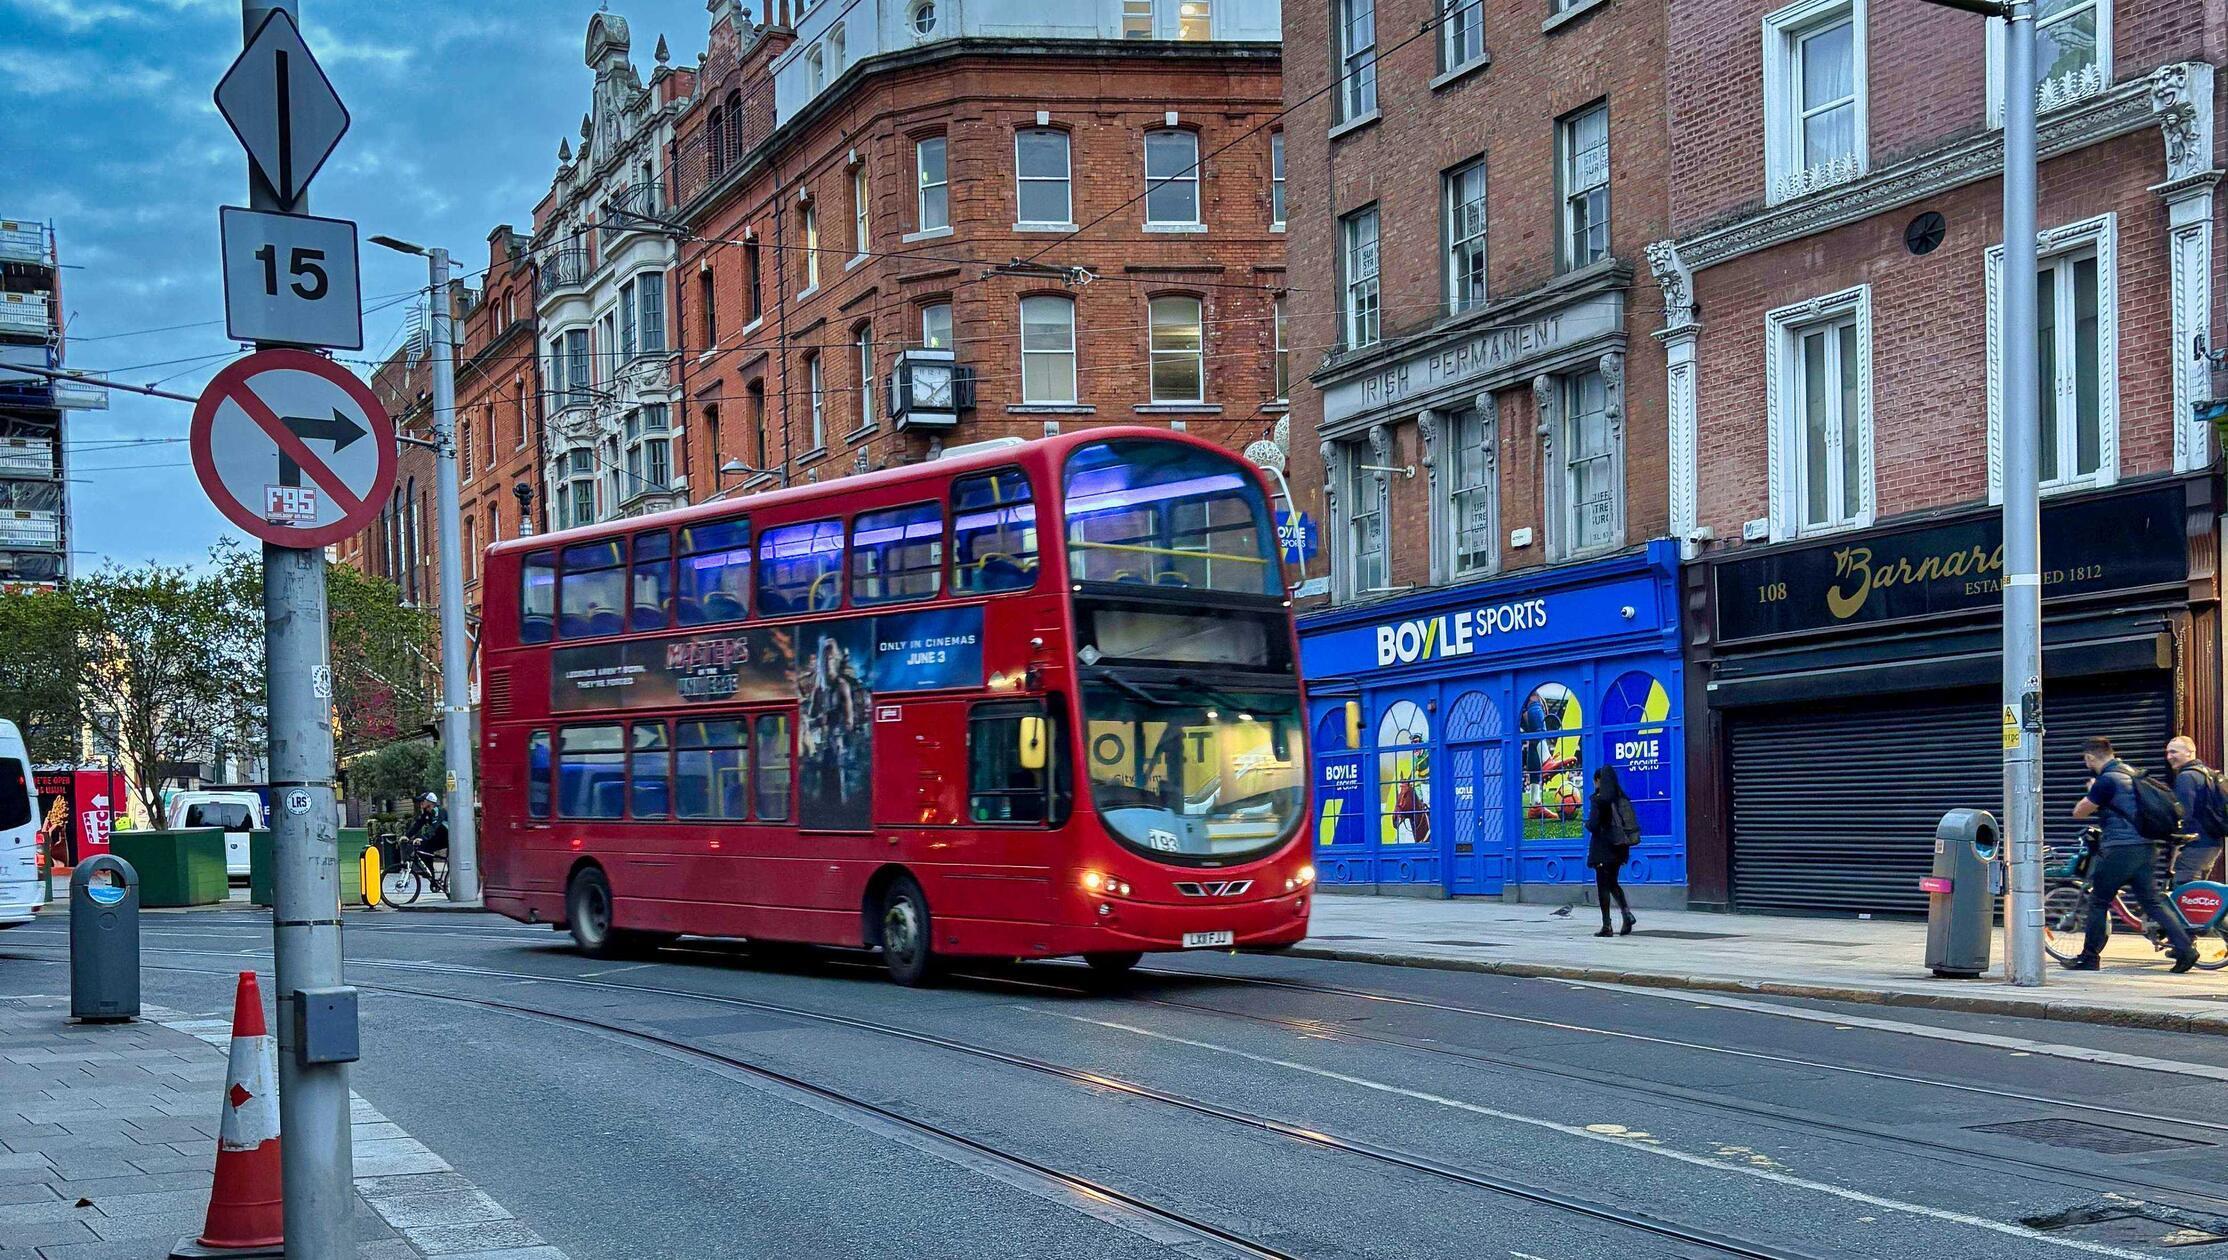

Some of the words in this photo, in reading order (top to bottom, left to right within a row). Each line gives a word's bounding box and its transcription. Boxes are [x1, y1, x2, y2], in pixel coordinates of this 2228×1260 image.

[256, 244, 328, 300] 15
[1361, 365, 1409, 406] IRISH
[1429, 313, 1564, 383] PERMANENT
[267, 487, 314, 514] F95
[2070, 564, 2102, 582] 1812
[1758, 582, 1787, 603] 108
[1377, 611, 1474, 666] BOYLE
[1476, 599, 1547, 636] SPORTS
[880, 641, 908, 652] ONLY
[910, 640, 921, 649] IN
[925, 635, 976, 648] CINEMAS
[907, 651, 936, 665] JUNE
[937, 651, 946, 663] 3
[1615, 740, 1659, 760] BOYLE
[1326, 764, 1358, 780] BOYLE
[291, 796, 307, 808] LRS
[95, 811, 109, 843] KFC
[1150, 834, 1177, 851] 193
